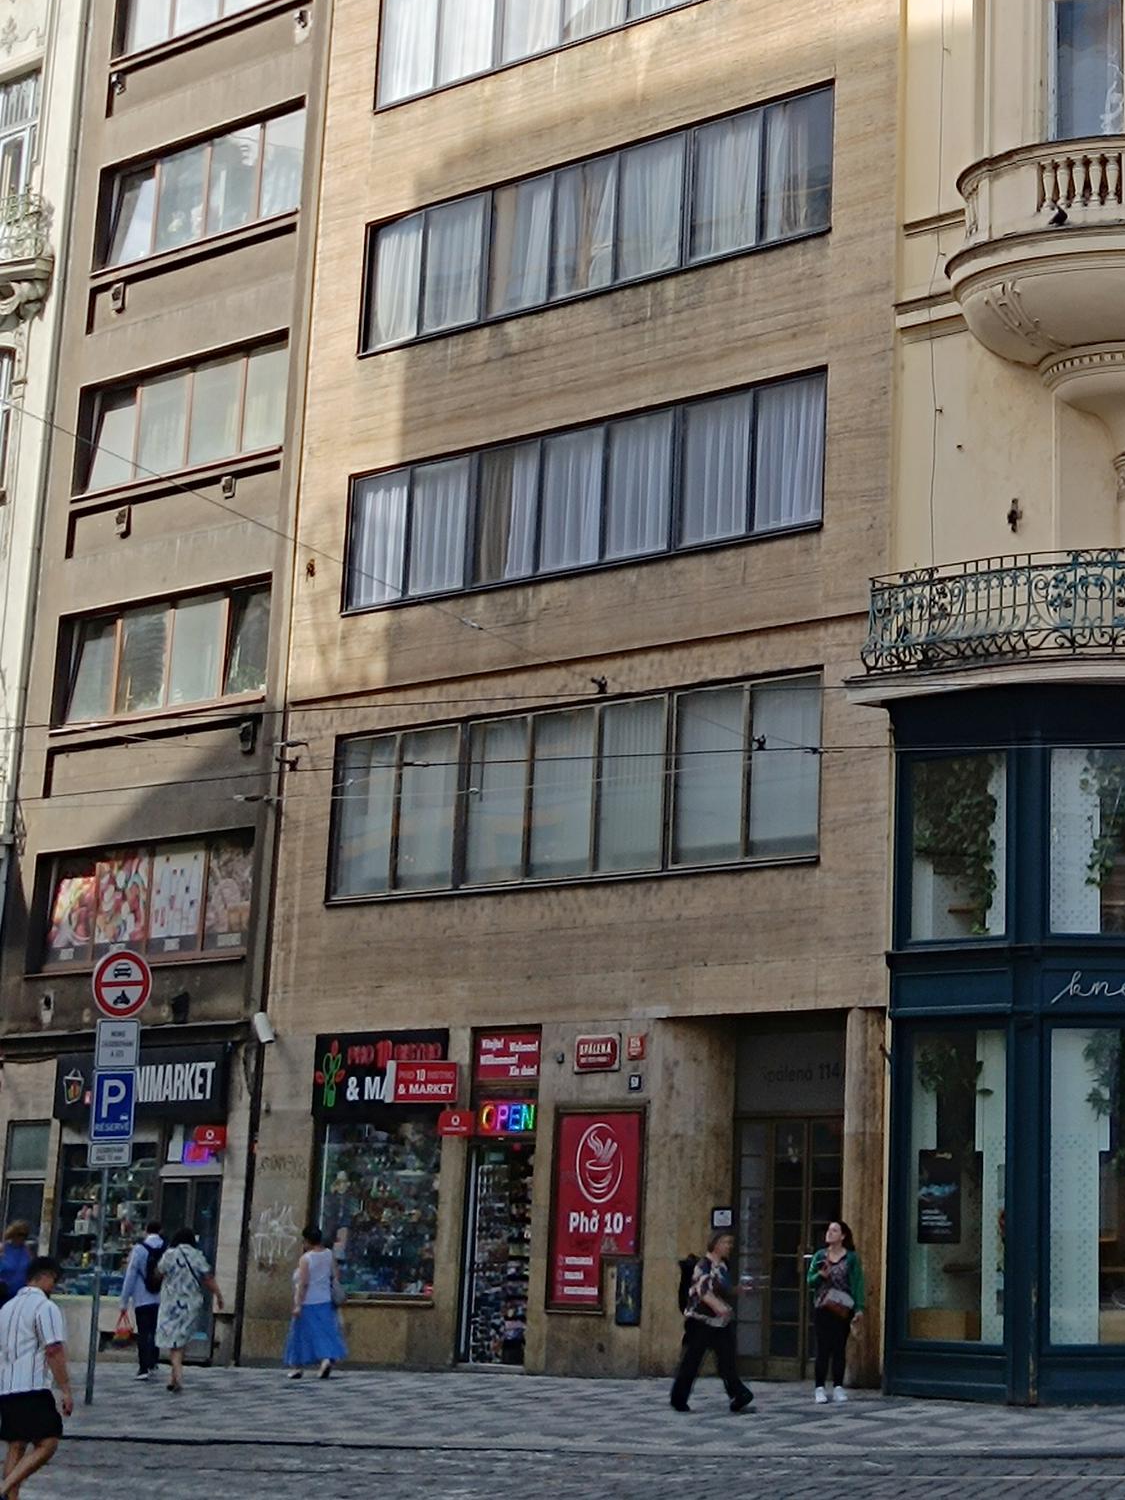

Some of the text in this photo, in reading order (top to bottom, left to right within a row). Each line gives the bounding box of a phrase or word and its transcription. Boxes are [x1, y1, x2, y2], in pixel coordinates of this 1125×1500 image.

[101, 1079, 126, 1118] P
[409, 1083, 454, 1095] MARKET
[480, 1103, 535, 1133] OPEN
[603, 1212, 623, 1234] 10
